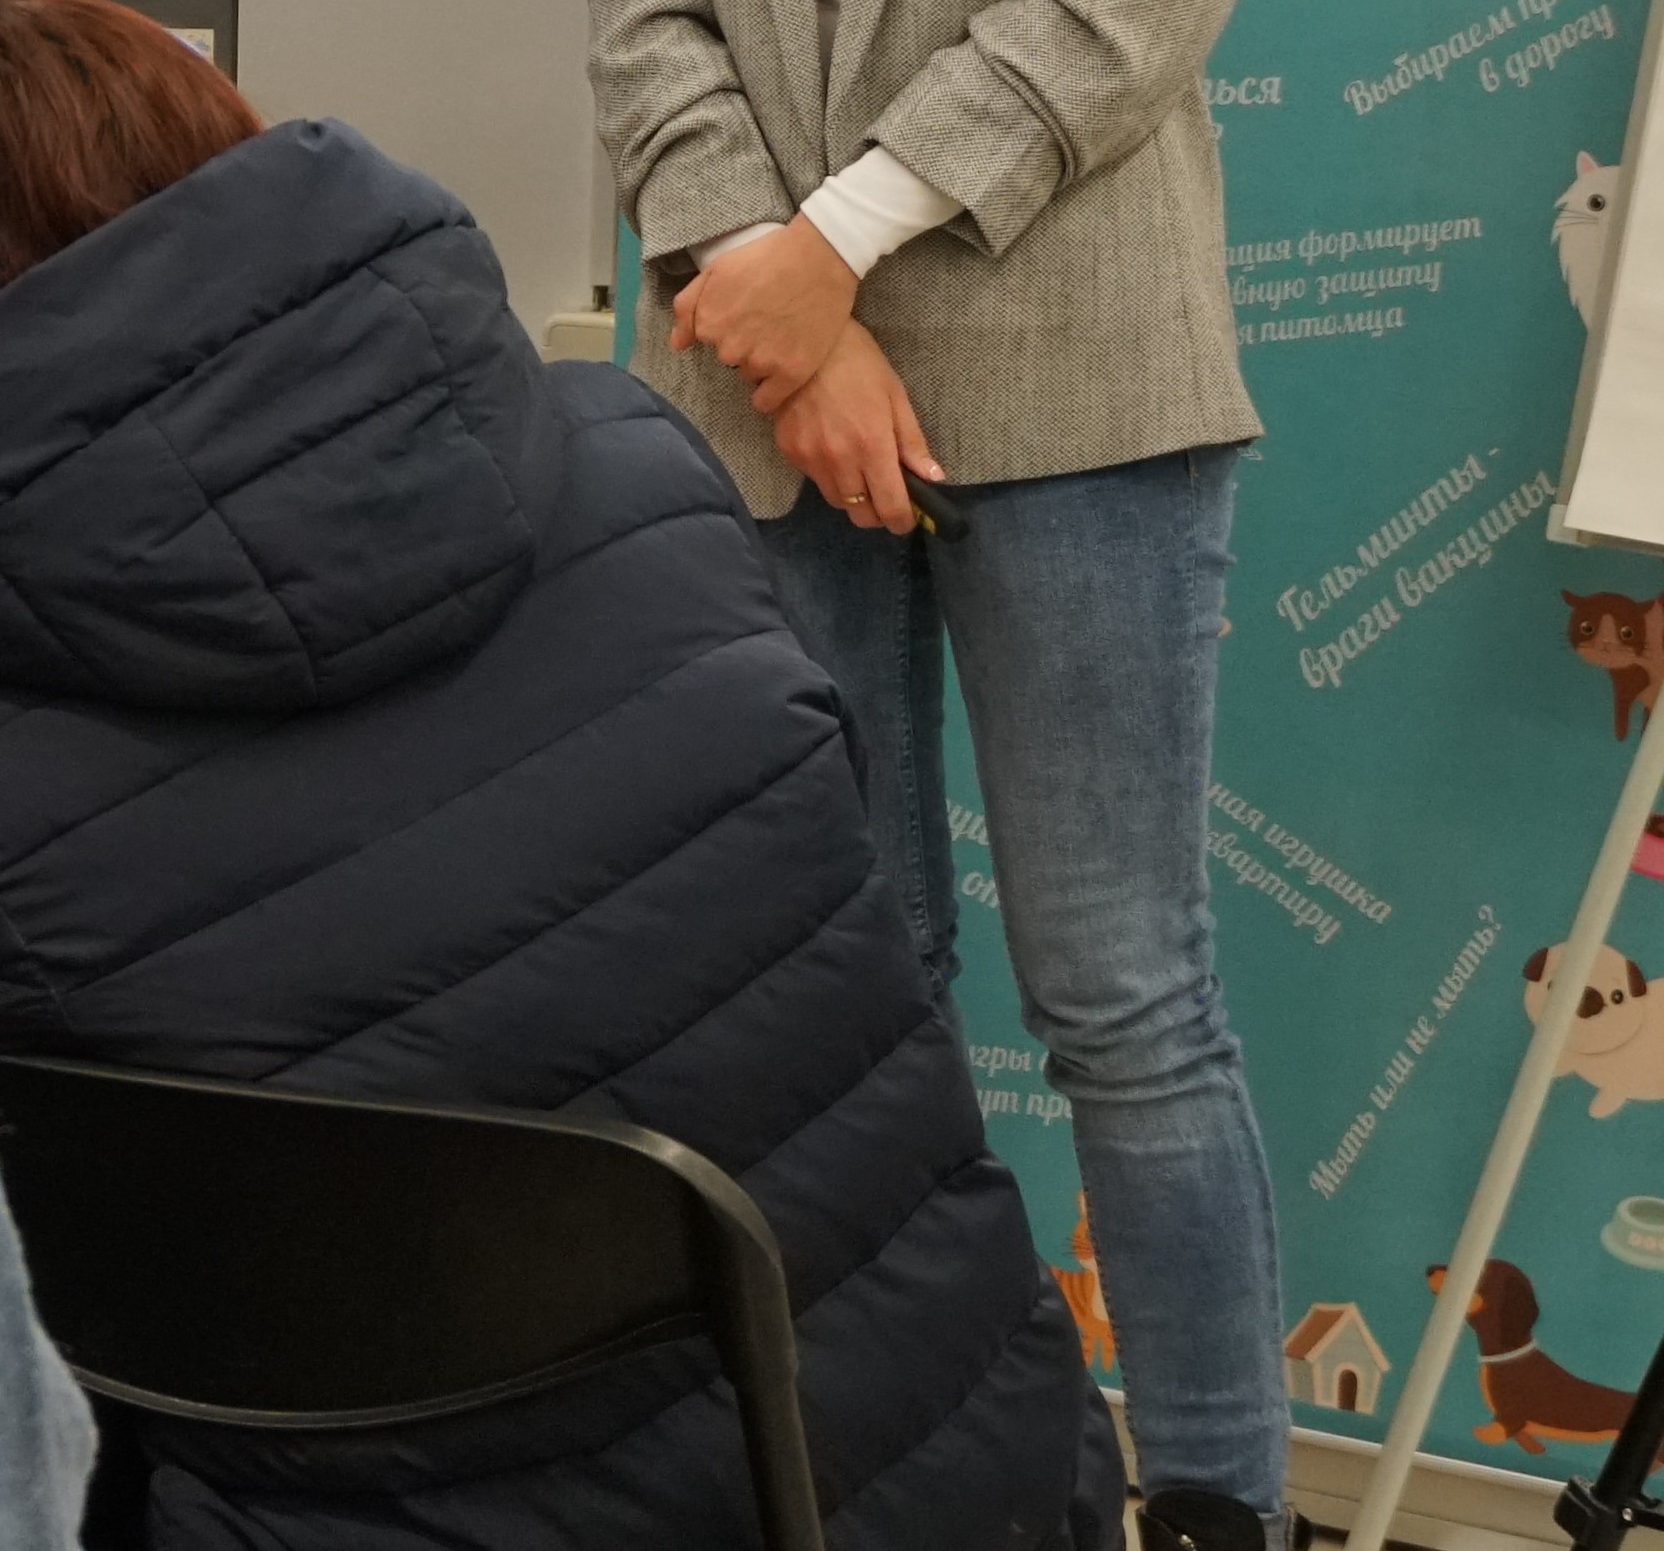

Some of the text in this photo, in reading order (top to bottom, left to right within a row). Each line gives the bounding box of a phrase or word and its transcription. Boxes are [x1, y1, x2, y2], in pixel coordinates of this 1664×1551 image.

[1343, 7, 1517, 117] Выбираем
[1507, 4, 1616, 89] дорогу
[1298, 214, 1483, 261] формирует
[1315, 259, 1442, 304] защиту
[1260, 304, 1405, 343] питомца
[1276, 454, 1488, 632] Гельминты
[1298, 470, 1558, 690] враги вакцины
[1271, 822, 1393, 927] игрушка
[1309, 903, 1504, 1202] Мыть или не мыть?
